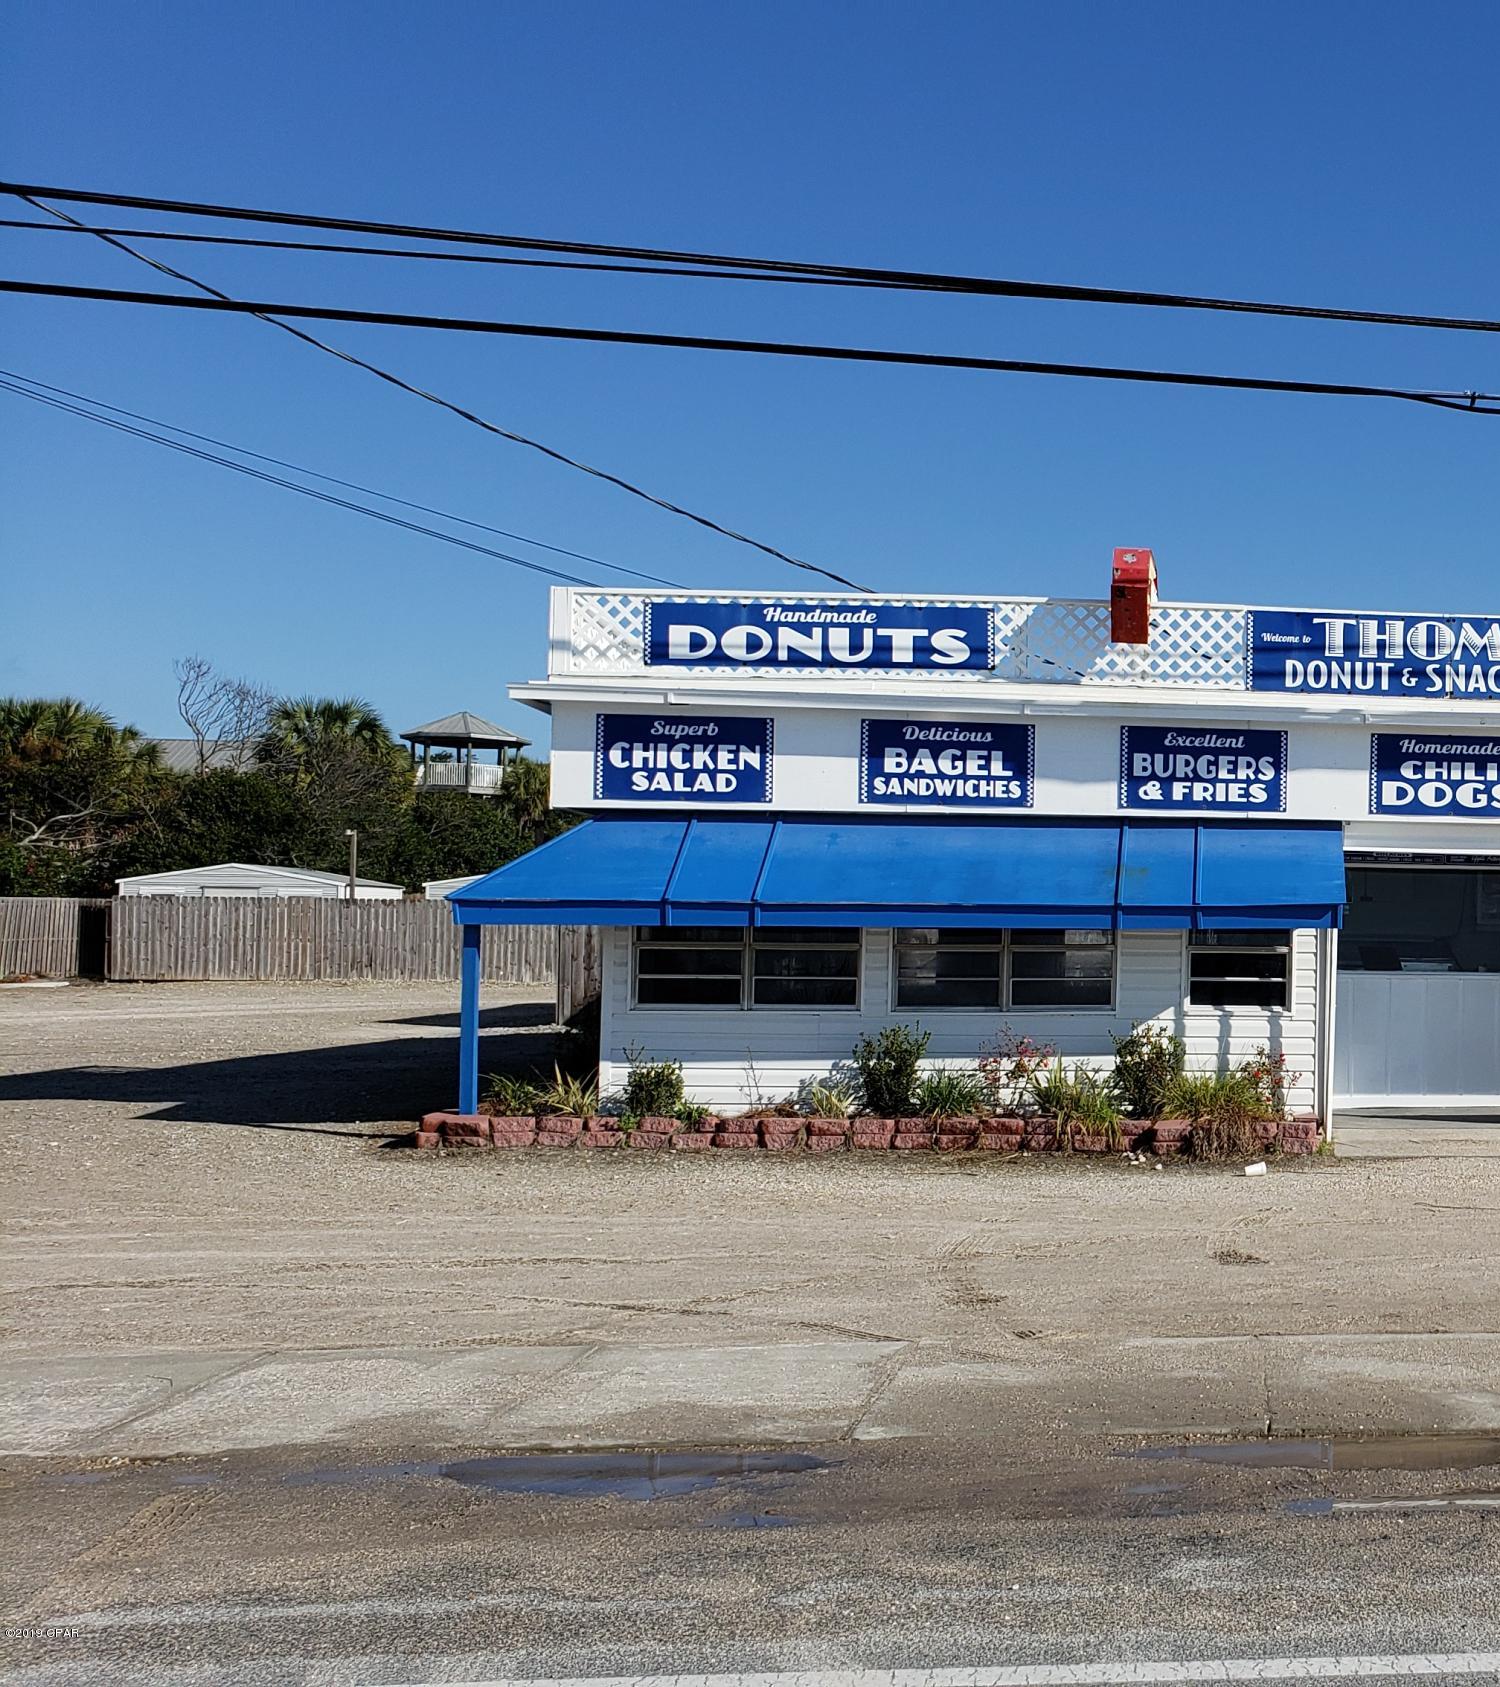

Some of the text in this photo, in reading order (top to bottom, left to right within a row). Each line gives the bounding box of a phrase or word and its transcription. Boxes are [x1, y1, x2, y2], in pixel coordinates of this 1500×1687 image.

[763, 606, 878, 623] Handmade
[668, 624, 971, 664] DONUTS
[1261, 632, 1312, 644] Welcome to
[1285, 659, 1394, 691] DONUT
[1401, 667, 1419, 687] &
[651, 720, 719, 739] Superb
[902, 725, 994, 742] Delicious
[1164, 732, 1245, 748] Excellent
[608, 741, 761, 771] CHICKEN
[883, 747, 1013, 776] BAGEL
[1133, 753, 1275, 781] BURGERS
[1400, 760, 1498, 781] CHILI
[631, 771, 737, 793] SALAD
[873, 777, 1022, 799] SANDWICHES
[1138, 780, 1268, 803] & FRIES
